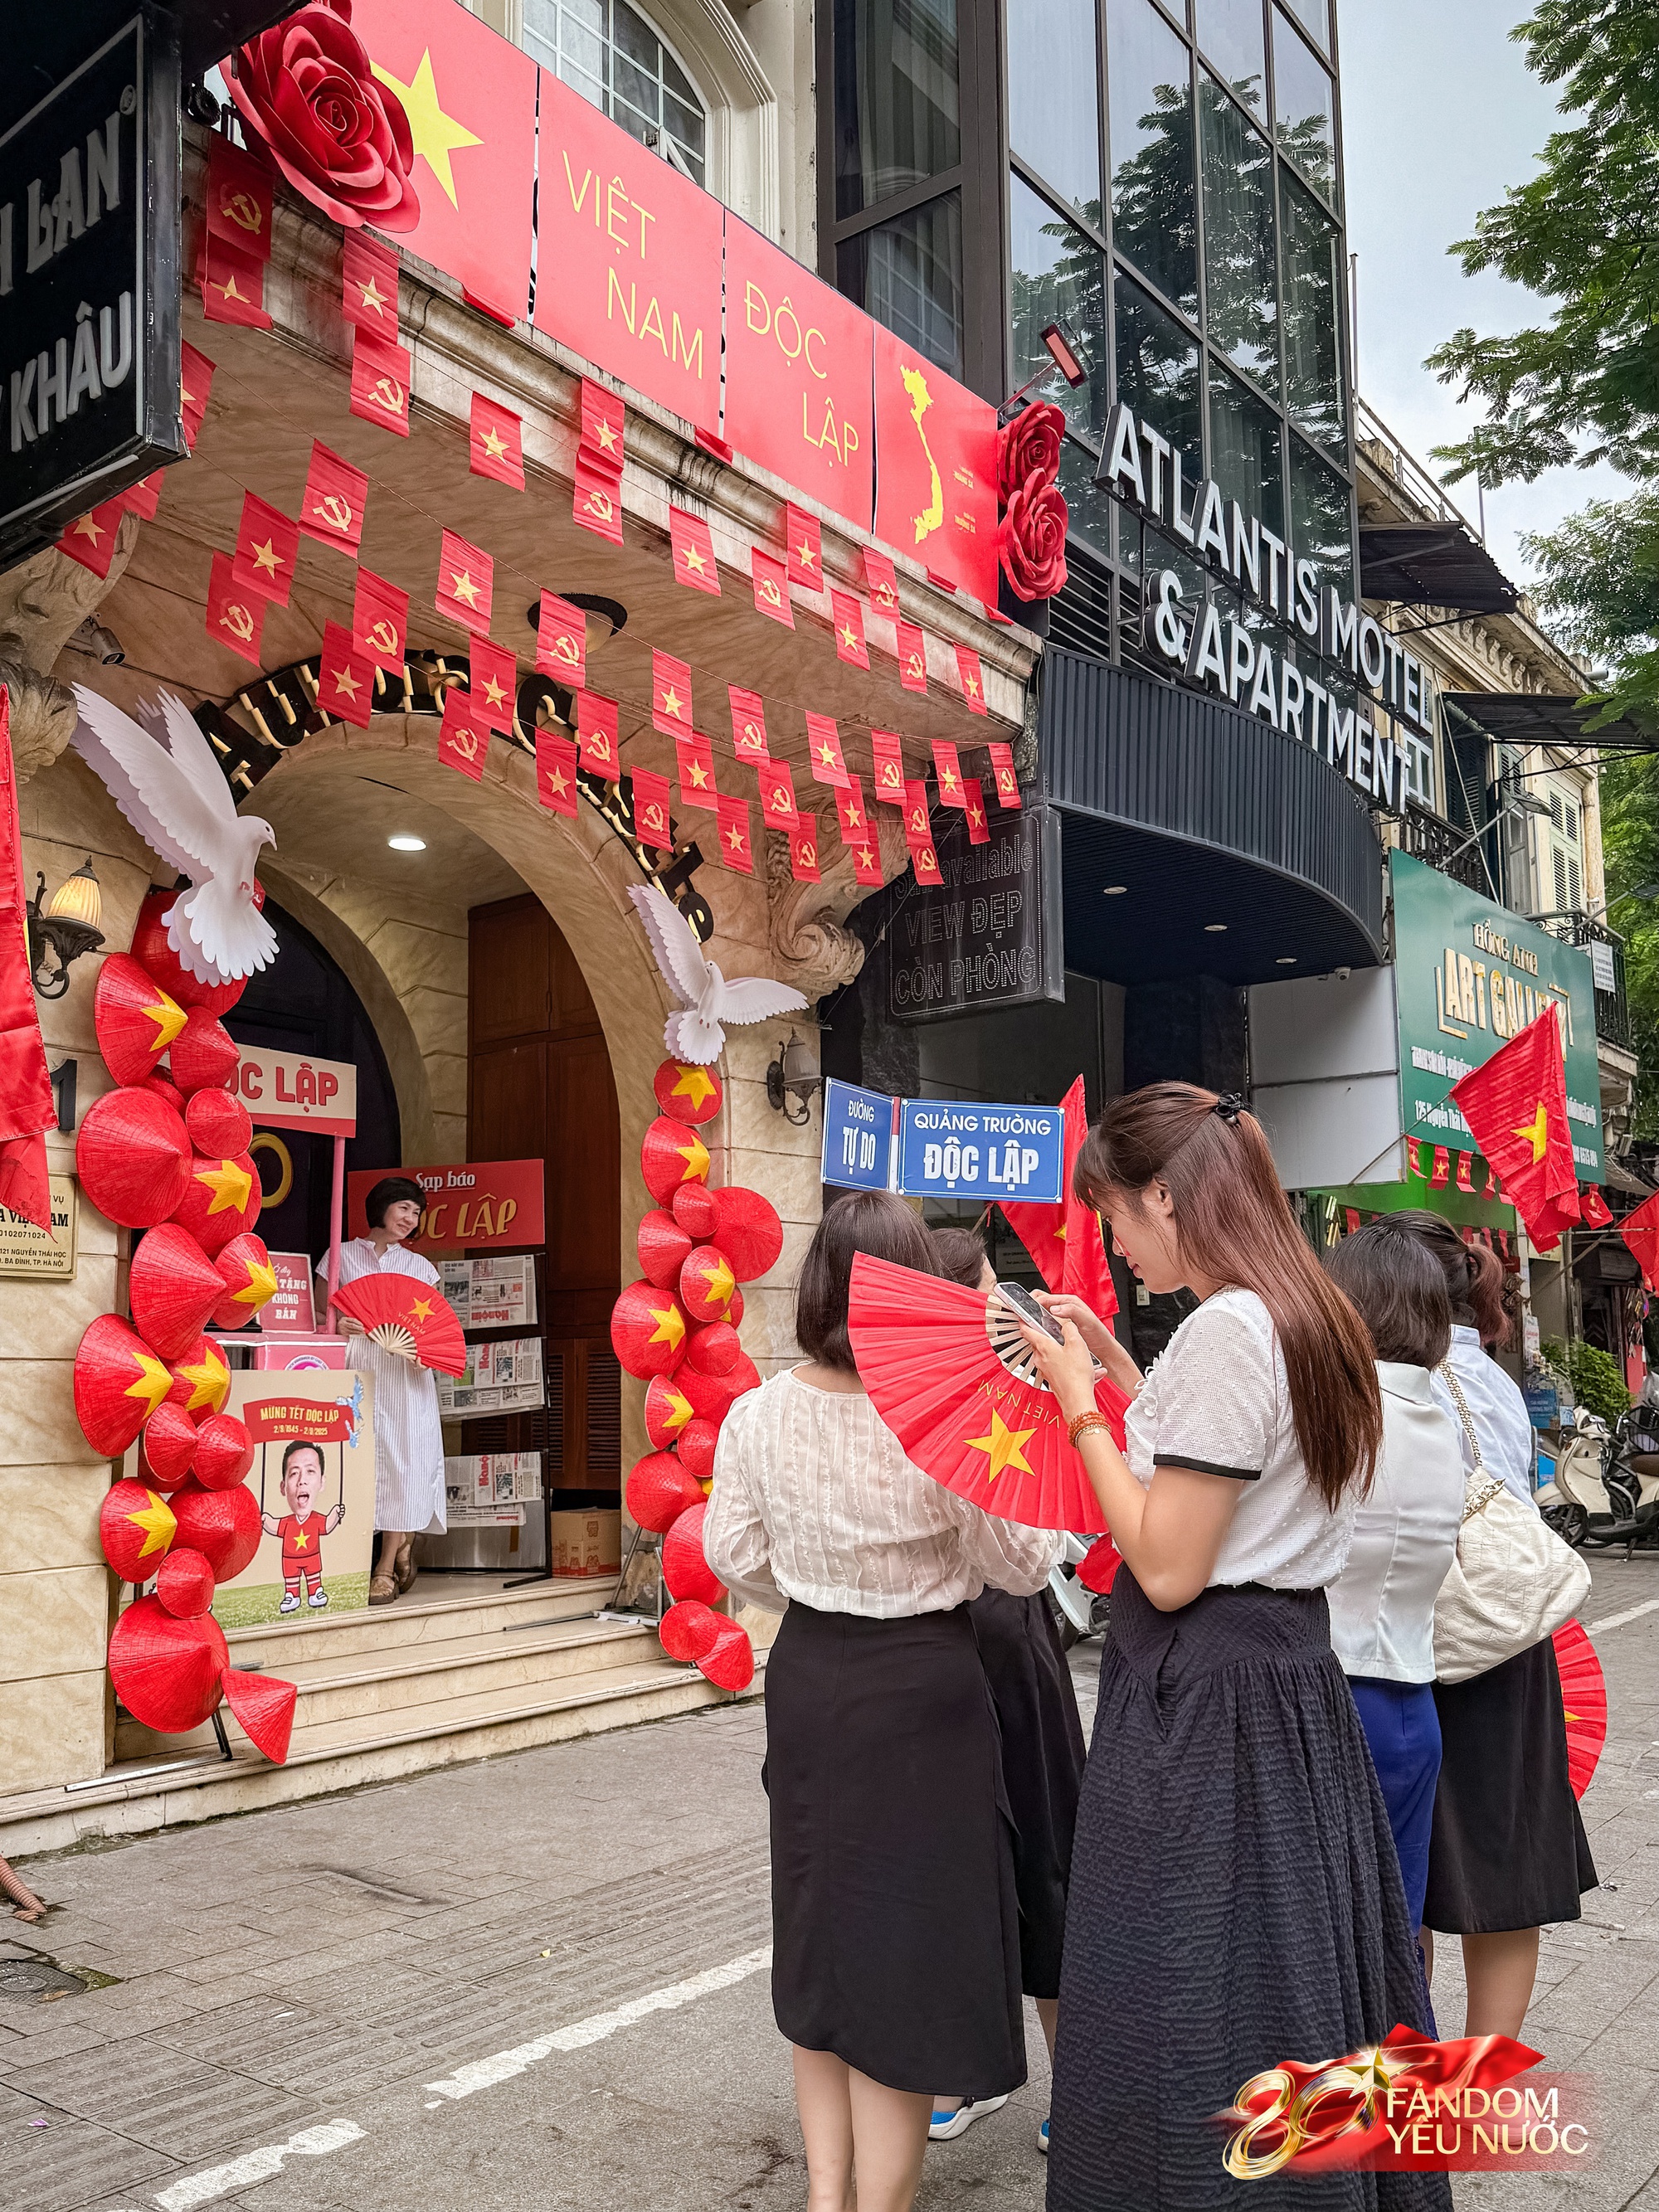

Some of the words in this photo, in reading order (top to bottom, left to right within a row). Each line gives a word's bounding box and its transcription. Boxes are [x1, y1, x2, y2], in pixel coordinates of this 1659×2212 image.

[562, 149, 656, 260] VIỆT
[606, 266, 704, 379] NAM
[743, 280, 827, 381] ĐỘC
[11, 290, 132, 453] KHÂU
[802, 392, 859, 468] LẬP
[1094, 402, 1318, 636] ATLANTIS
[1321, 586, 1433, 737] MOTEL
[1144, 569, 1187, 664] &
[1185, 602, 1412, 814] APARTMENT
[904, 900, 966, 946] VIEW
[971, 890, 1023, 939] ĐẸP
[895, 956, 943, 1004] CÒN
[951, 942, 1036, 996] PHÒNG
[1444, 947, 1486, 1029] ART
[1511, 944, 1539, 977] ANH
[275, 1062, 338, 1113] LẬP
[848, 1099, 875, 1123] ĐƯỜNG
[842, 1125, 859, 1175] TỰ
[859, 1133, 876, 1171] DO
[913, 1108, 979, 1132] QUẢNG
[982, 1112, 1052, 1136] TRƯỜNG
[416, 1173, 443, 1193] Sạp
[446, 1170, 475, 1188] báo
[923, 1135, 980, 1189] ĐỘC
[988, 1139, 1039, 1192] LẬP
[51, 1213, 69, 1227] AM
[53, 1195, 64, 1204] VỤ
[455, 1193, 517, 1239] LẬP
